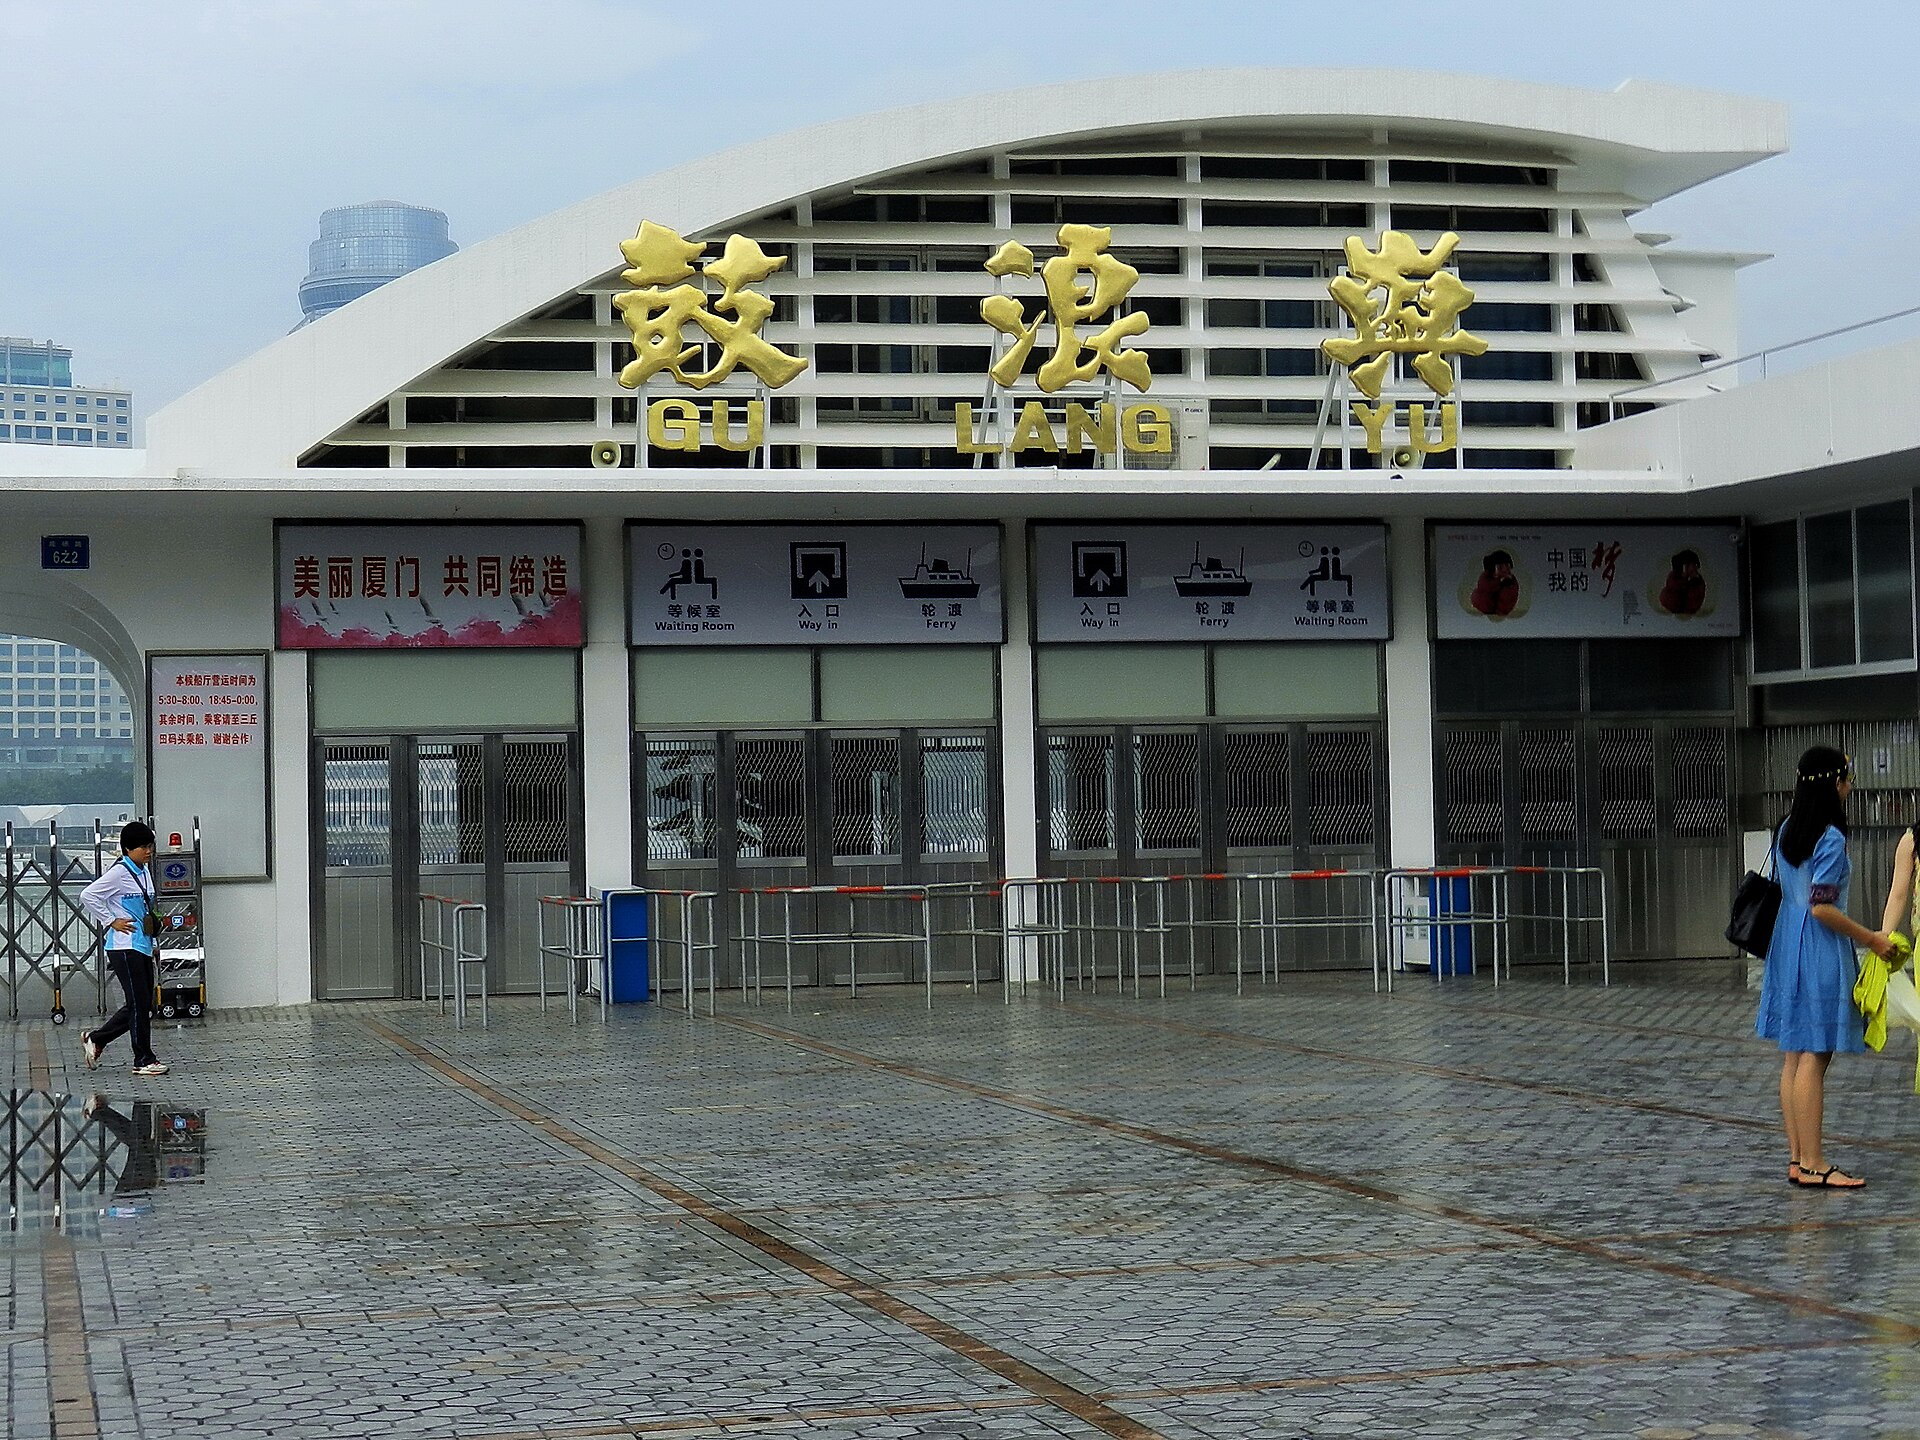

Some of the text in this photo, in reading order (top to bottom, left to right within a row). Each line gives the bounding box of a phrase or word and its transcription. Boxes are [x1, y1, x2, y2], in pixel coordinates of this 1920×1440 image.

[647, 399, 1457, 455] GU LANG YU
[53, 549, 79, 564] 6之2
[1547, 547, 1588, 569] 中国
[293, 554, 569, 599] 美丽厦门 共同缔造
[1548, 571, 1589, 593] 我的
[667, 604, 721, 619] 等候室
[797, 604, 840, 618] 入口
[921, 602, 962, 618] 轮渡
[1079, 602, 1121, 616] 入口
[1195, 601, 1235, 616] 轮渡
[1305, 600, 1355, 614] 等候室
[655, 620, 735, 634] Waiting Room
[798, 620, 838, 632] Way in
[926, 618, 957, 631] Ferry
[1081, 617, 1119, 629] Way in
[1200, 616, 1230, 629] Ferry
[1294, 615, 1369, 628] Waiting Room
[175, 674, 257, 687] 本候船厅营运时间为
